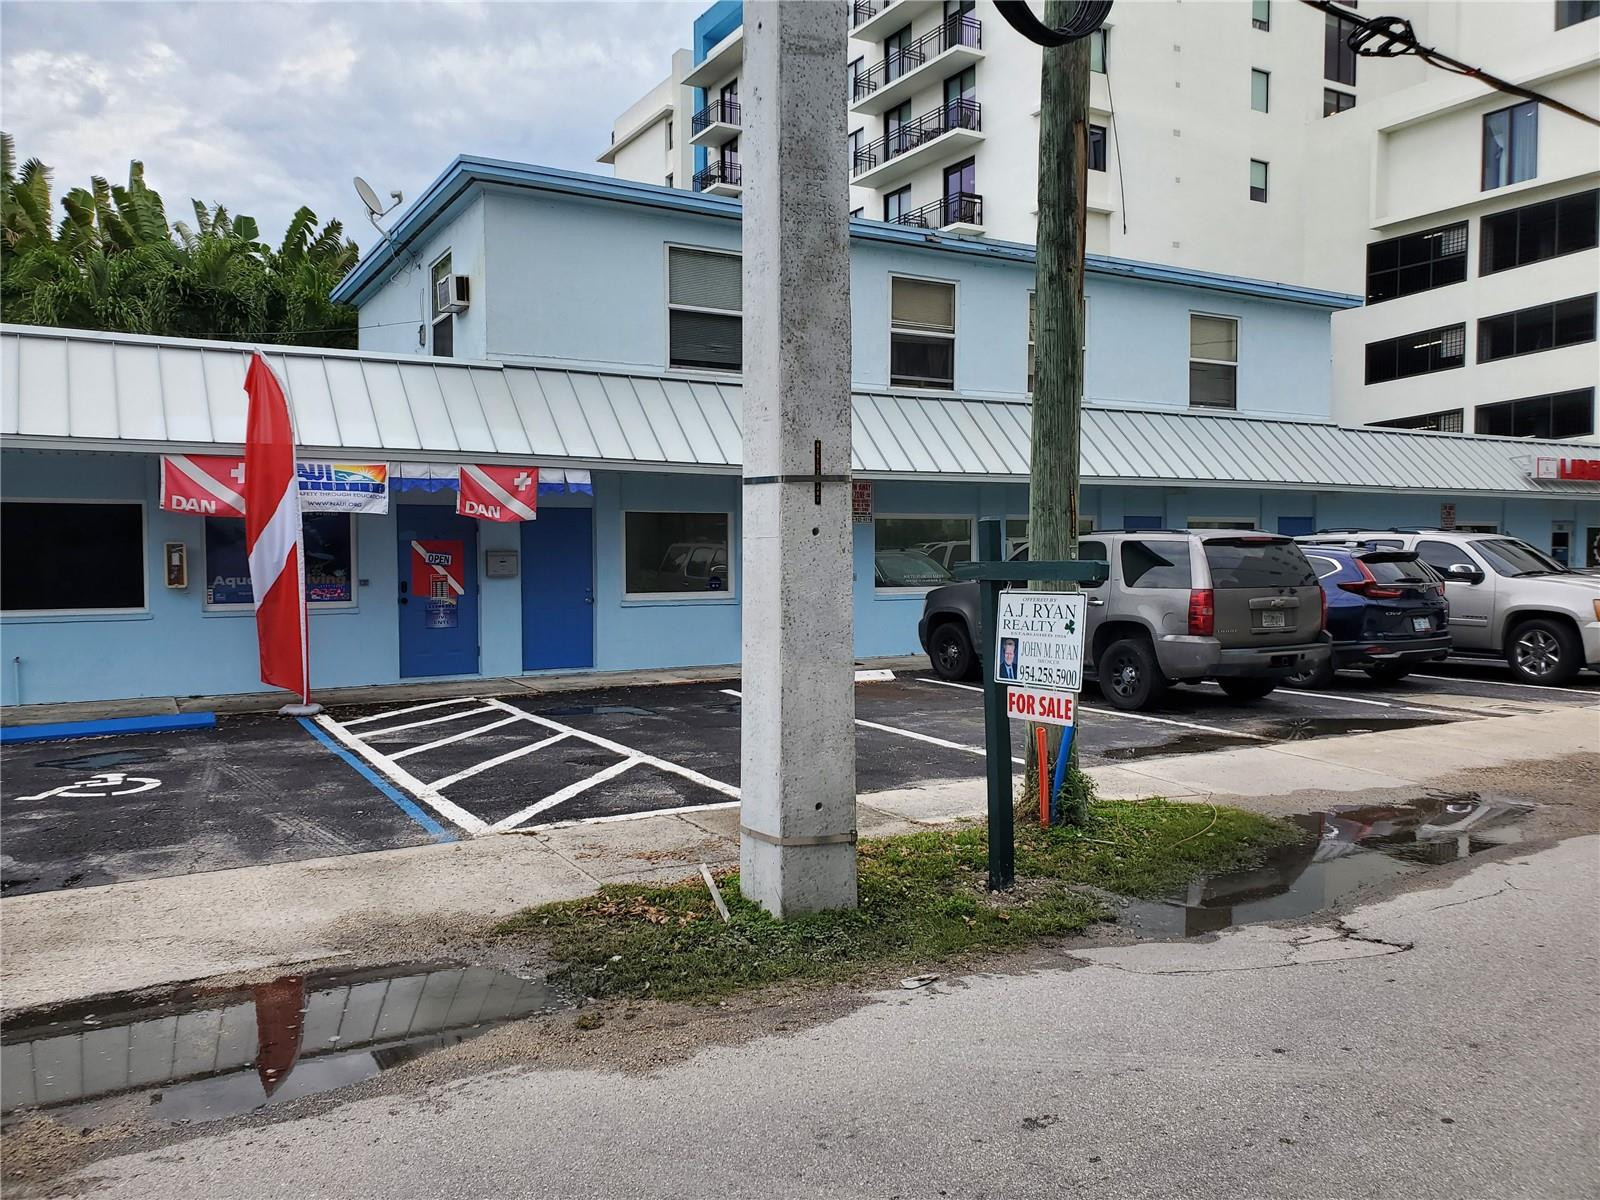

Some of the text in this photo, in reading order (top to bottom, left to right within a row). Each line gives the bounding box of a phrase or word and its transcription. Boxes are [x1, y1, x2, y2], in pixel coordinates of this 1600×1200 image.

[171, 495, 216, 514] DAN
[465, 501, 501, 519] DAN
[428, 554, 450, 564] OPEN
[1003, 603, 1077, 619] A.J. RYAN
[1003, 619, 1056, 632] REALTY
[1020, 641, 1079, 661] JOHN M. RYAN
[1020, 664, 1077, 686] 954.258.5900
[1008, 692, 1072, 720] FOR SALE
